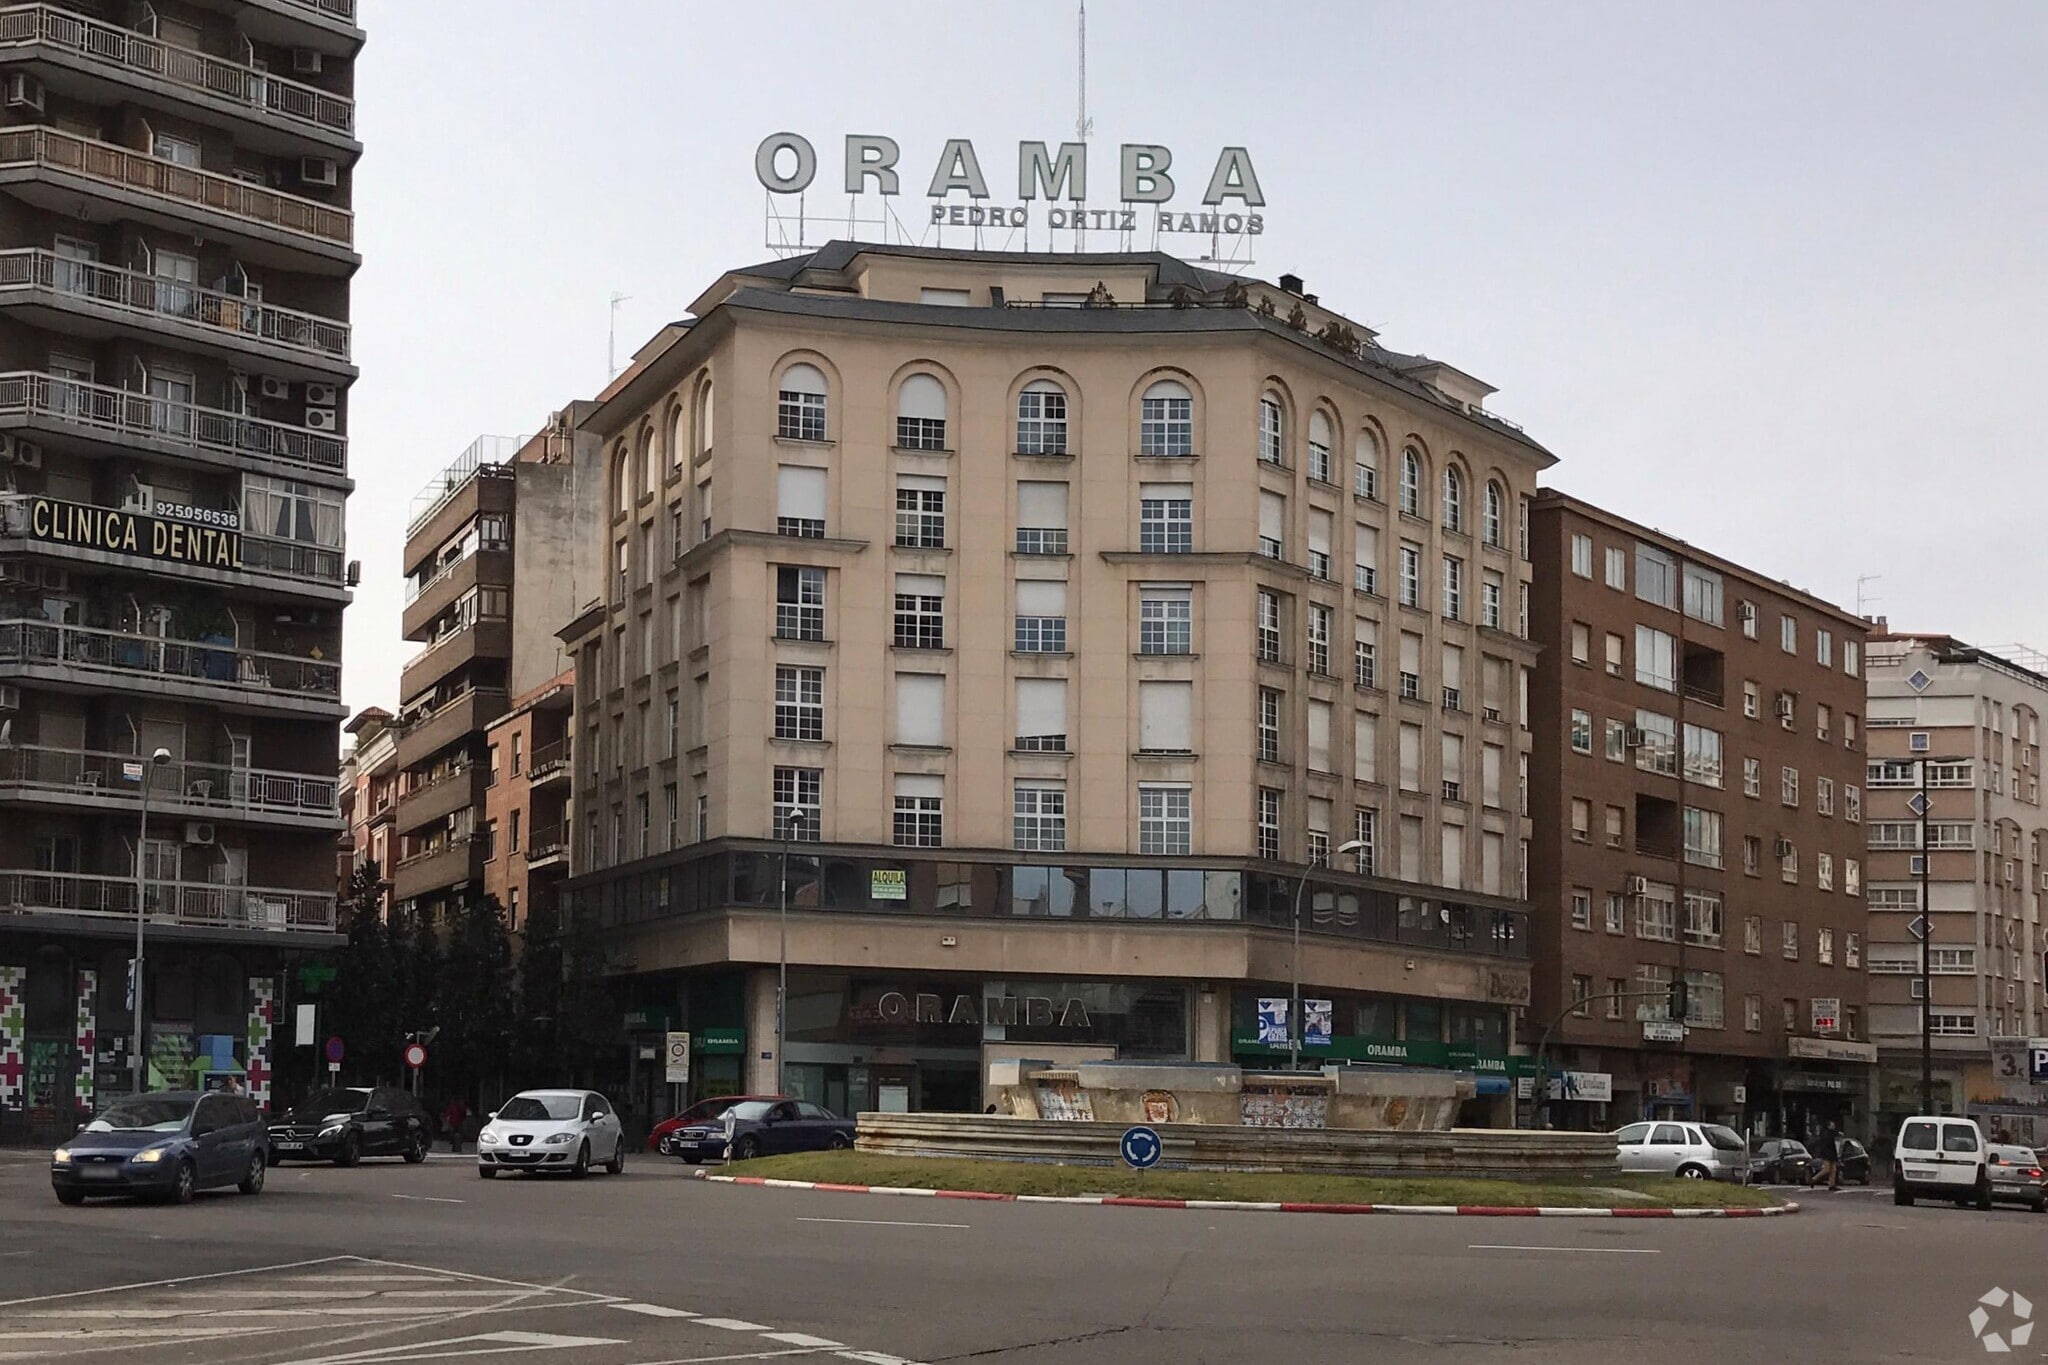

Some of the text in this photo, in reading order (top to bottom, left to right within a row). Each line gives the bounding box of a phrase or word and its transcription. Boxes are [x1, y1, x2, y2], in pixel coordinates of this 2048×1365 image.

[755, 132, 1266, 207] ORAMBA
[931, 205, 1264, 235] PEDRO ORTIZ RAMOS
[33, 500, 244, 569] CLINICA DENTAL
[873, 871, 905, 885] ALQUILA
[878, 991, 1092, 1027] ORAMBA
[1367, 1044, 1408, 1057] ORAMBA
[2034, 1050, 2048, 1073] P
[1472, 1059, 1506, 1071] RAMBA
